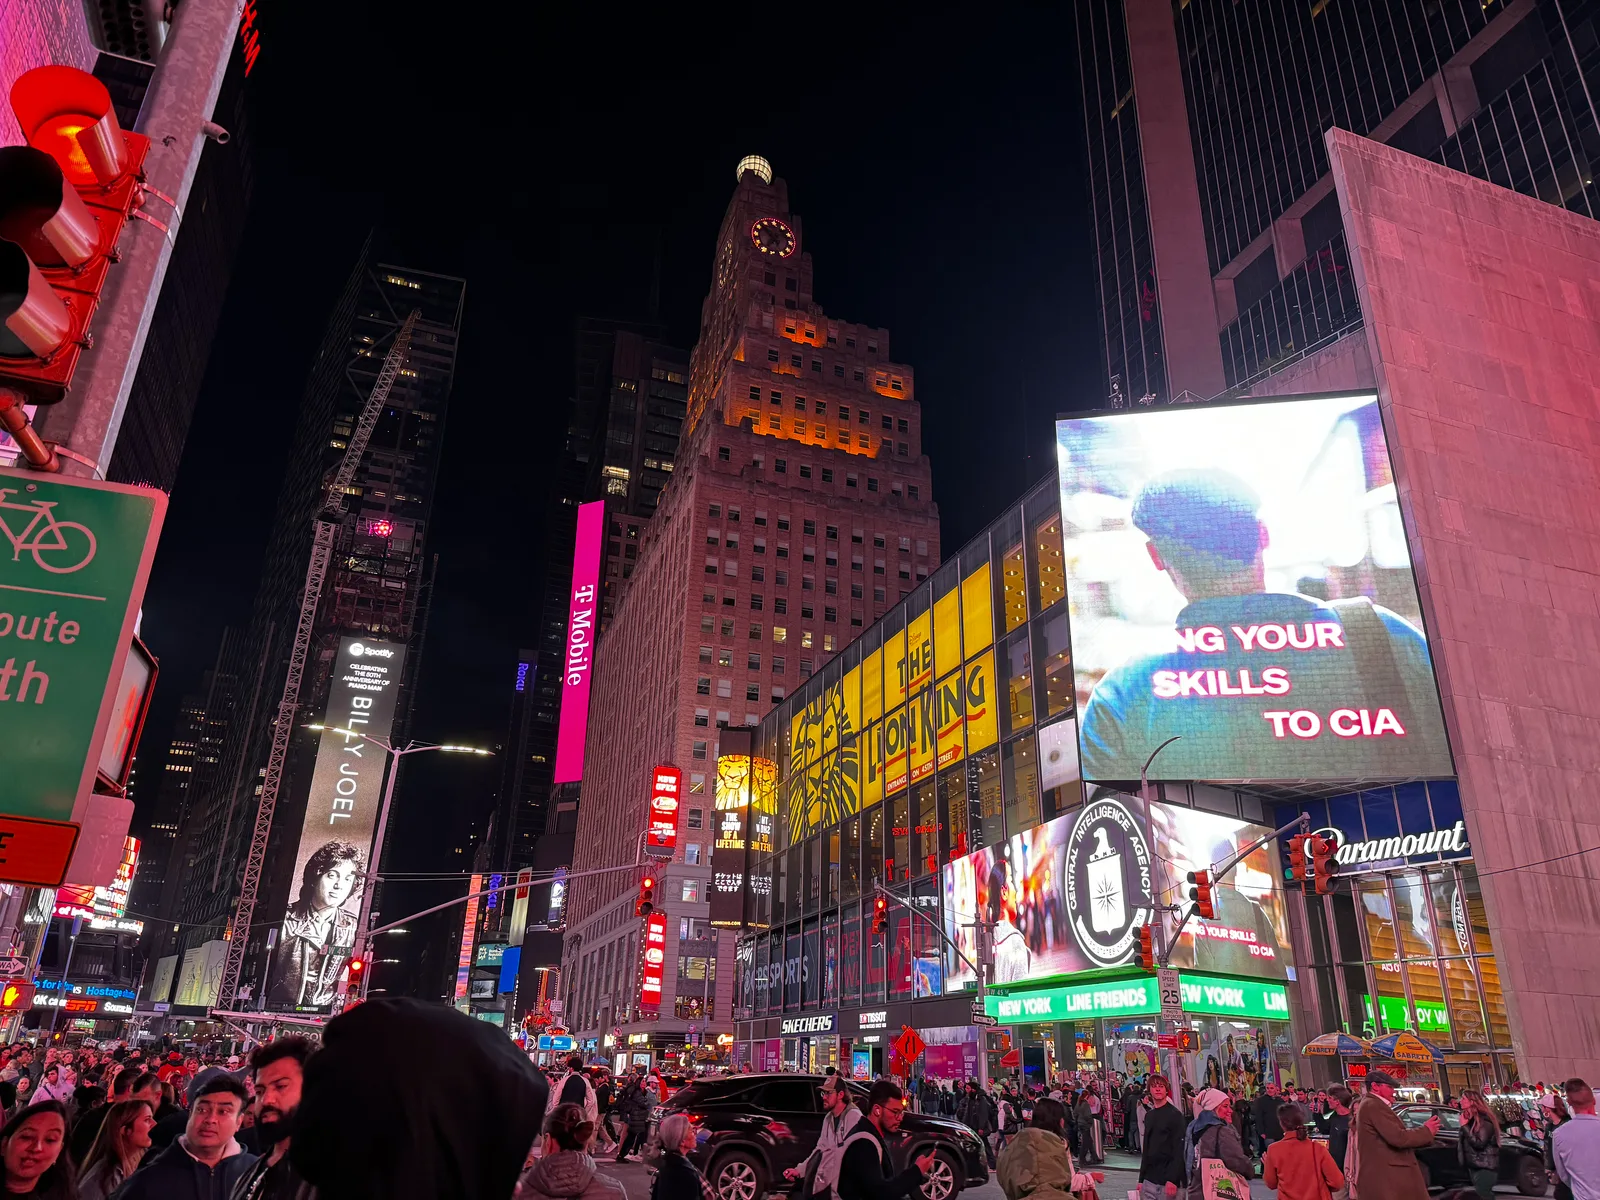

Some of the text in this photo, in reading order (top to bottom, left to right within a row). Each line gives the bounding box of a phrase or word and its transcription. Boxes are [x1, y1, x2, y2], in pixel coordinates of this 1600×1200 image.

[1232, 623, 1344, 650] YOUR
[364, 647, 394, 658] Spotify
[350, 664, 387, 673] CELEBRATING
[897, 639, 931, 688] THE
[343, 676, 381, 684] ANNIVERSARY
[1153, 667, 1290, 697] SKILLS
[867, 664, 986, 784] LION KING
[1264, 709, 1404, 738] TO CIA
[330, 696, 373, 825] BILLY JOEL
[887, 750, 953, 790] ENTRANCE ON 45TH STREET
[721, 821, 741, 831] SHOW
[725, 812, 738, 822] THE
[1076, 805, 1131, 842] INTELLIGENCE
[715, 840, 745, 849] LIFETIME
[723, 831, 738, 840] OF A
[1129, 836, 1151, 899] AGENCY
[1068, 847, 1079, 910] CENTRAL
[1206, 926, 1228, 938] YOUR
[1229, 929, 1256, 942] SKILLS
[1248, 945, 1274, 956] TO CIA
[769, 955, 808, 989] SPORTS
[33, 994, 47, 1005] OK
[998, 987, 1147, 1017] NEW YORK LINE FRIENDS
[1162, 989, 1179, 1004] 25
[1203, 986, 1246, 1009] YORK
[782, 1015, 832, 1034] SKECHERS
[867, 1011, 887, 1023] TISSOT
[1396, 1052, 1431, 1061] SABRETT
